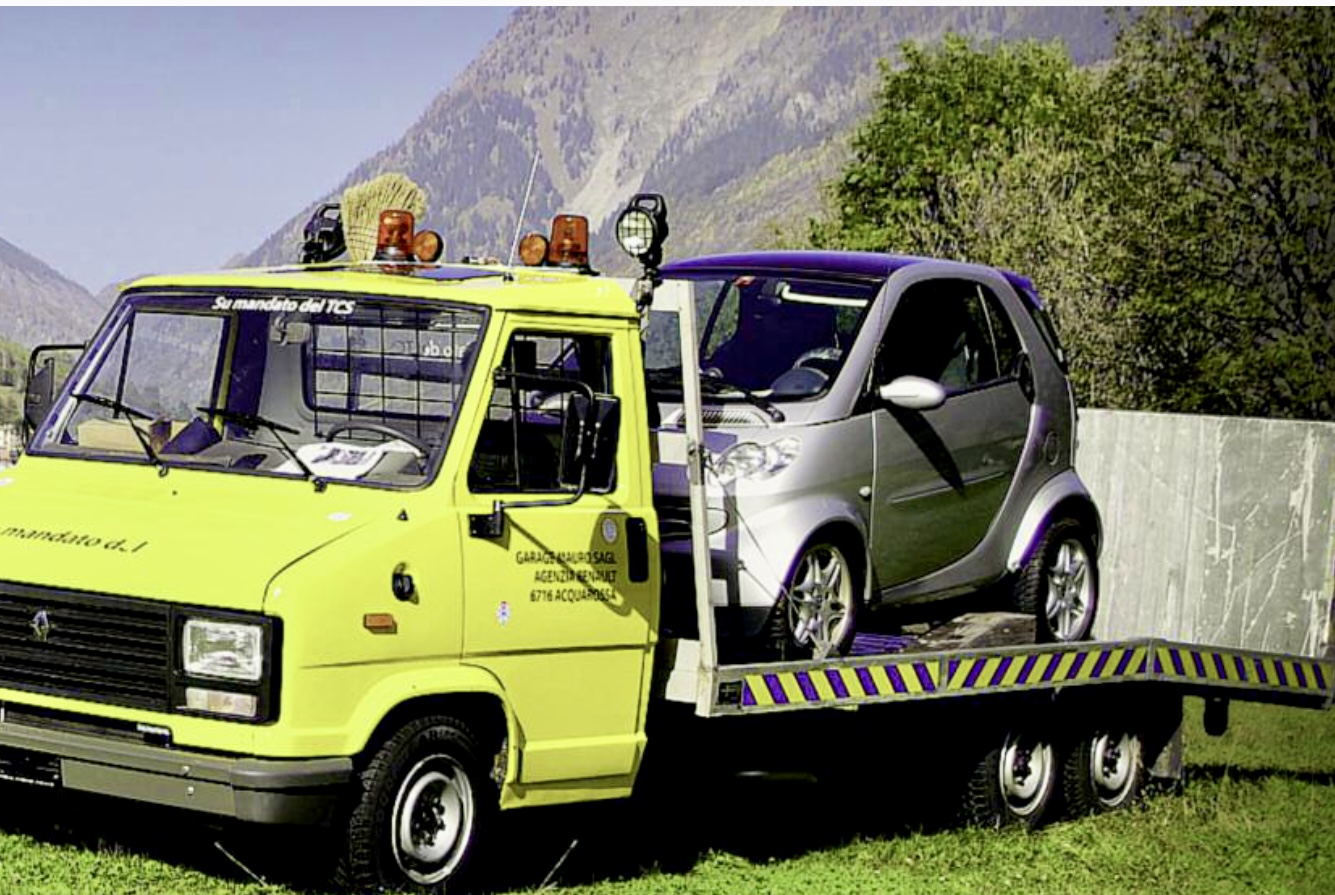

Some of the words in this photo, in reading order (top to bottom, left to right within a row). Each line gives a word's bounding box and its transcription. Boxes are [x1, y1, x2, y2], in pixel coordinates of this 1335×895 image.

[211, 296, 232, 310] Su
[232, 296, 298, 312] mandato
[298, 297, 326, 313] del
[325, 299, 356, 315] TCS
